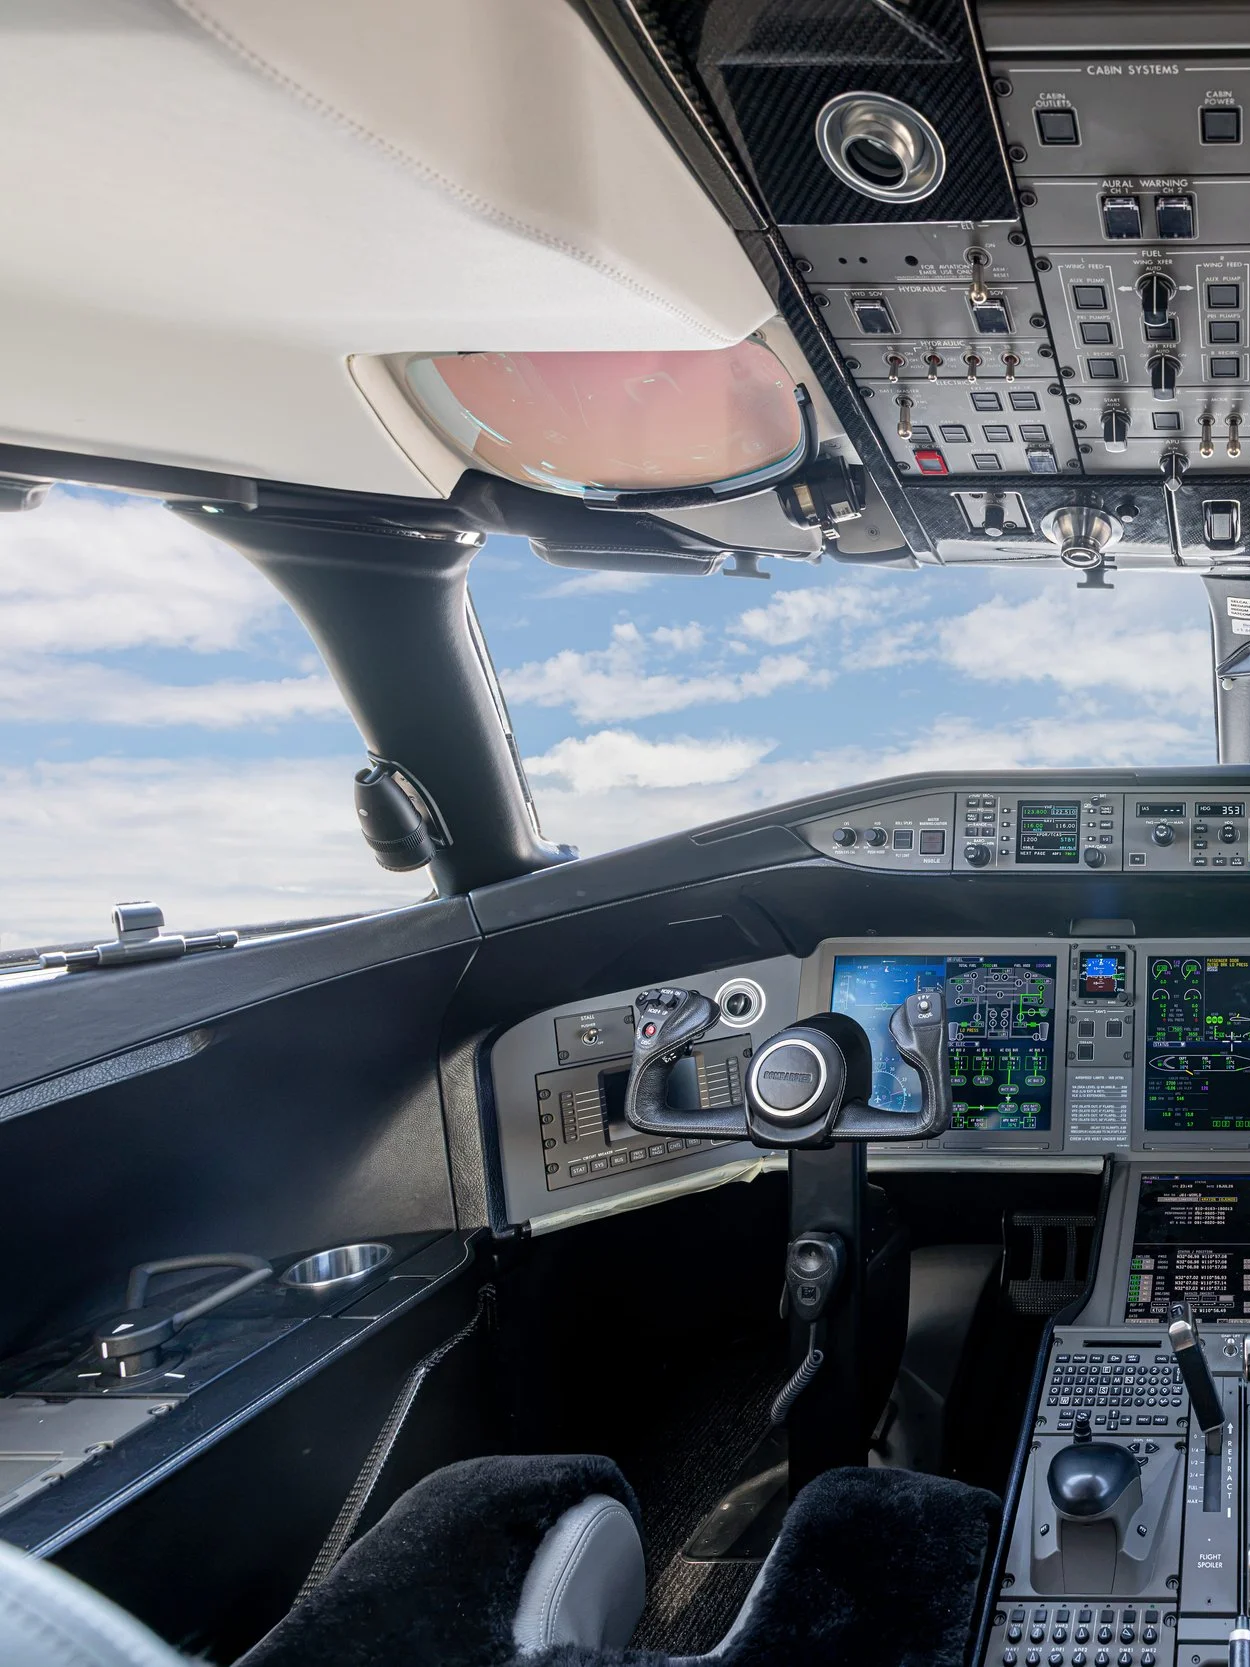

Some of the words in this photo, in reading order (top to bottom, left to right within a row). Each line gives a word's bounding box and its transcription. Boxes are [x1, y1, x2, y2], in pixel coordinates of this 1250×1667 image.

[1087, 65, 1122, 75] CABIN
[1128, 65, 1179, 75] SYSTEMS
[1102, 179, 1133, 188] AURAL
[1140, 179, 1188, 187] WARNING
[1222, 806, 1240, 815] 353
[763, 1070, 813, 1083] BOMBARDIER
[573, 1166, 585, 1174] STAT
[1197, 1561, 1223, 1569] SPOILER
